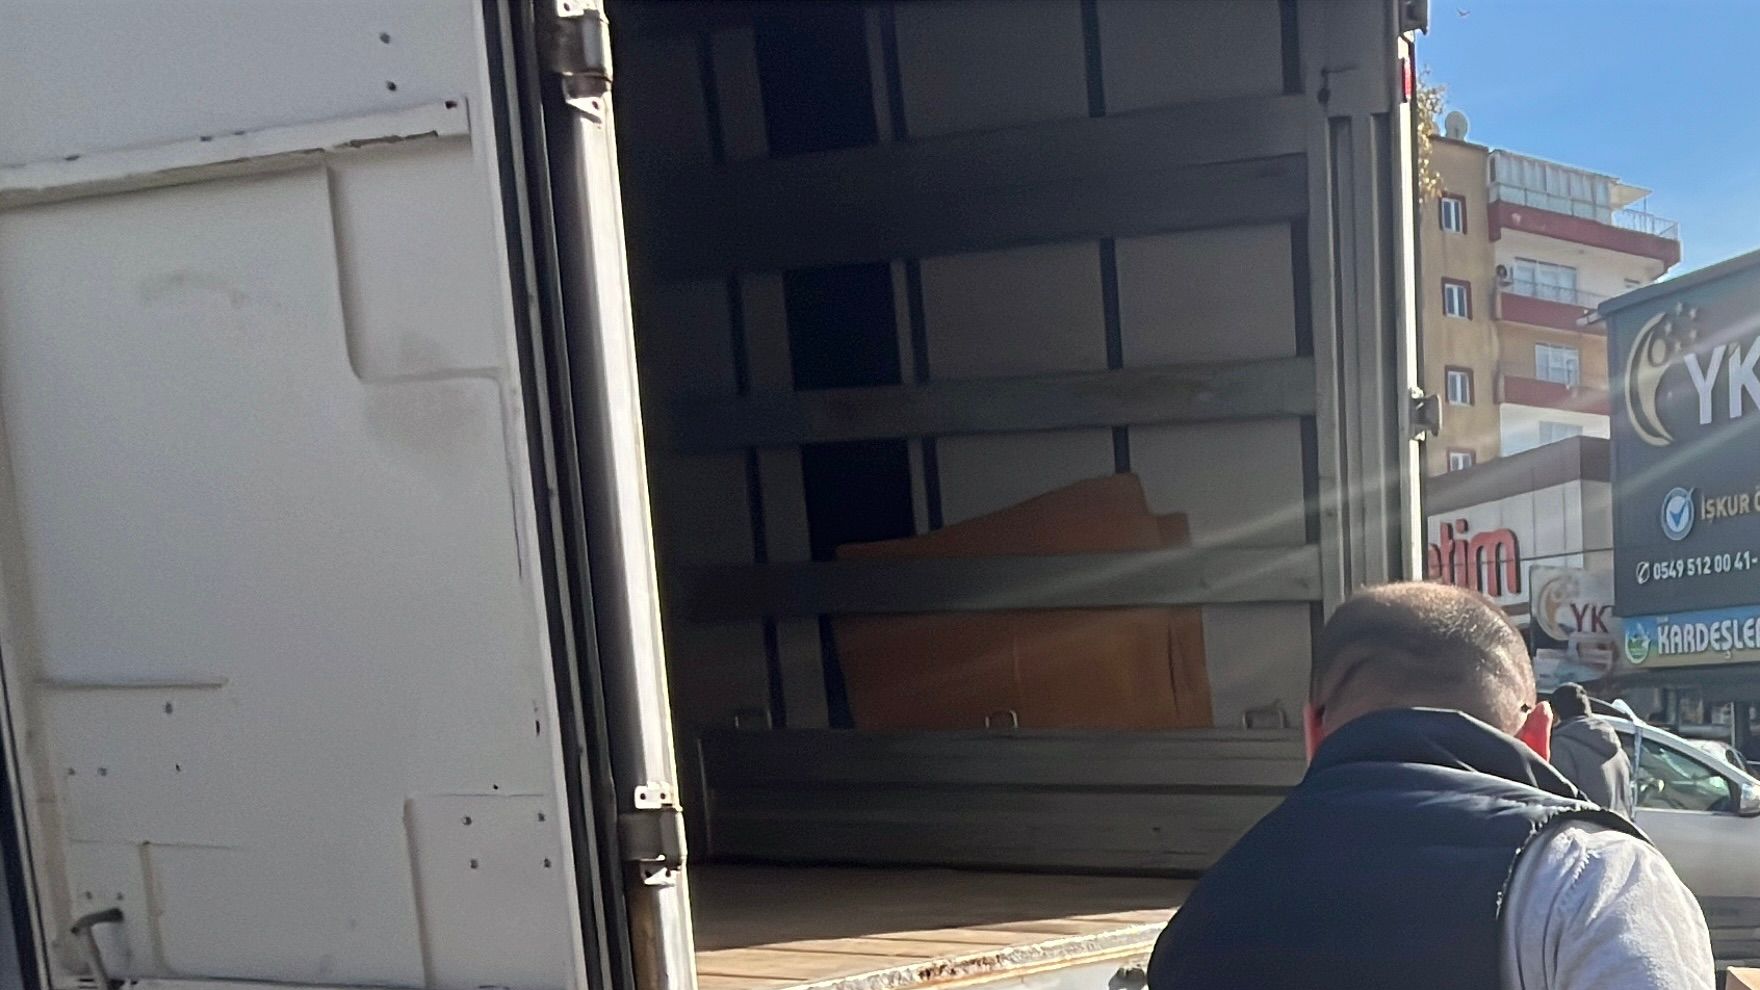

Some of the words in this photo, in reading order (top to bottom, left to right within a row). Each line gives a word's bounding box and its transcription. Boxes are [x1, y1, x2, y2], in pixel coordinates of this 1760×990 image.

[1700, 492, 1750, 524] İŞKUR
[1653, 556, 1684, 581] 0549
[1687, 554, 1711, 577] 512
[1714, 553, 1731, 573] 00
[1570, 602, 1609, 633] YK
